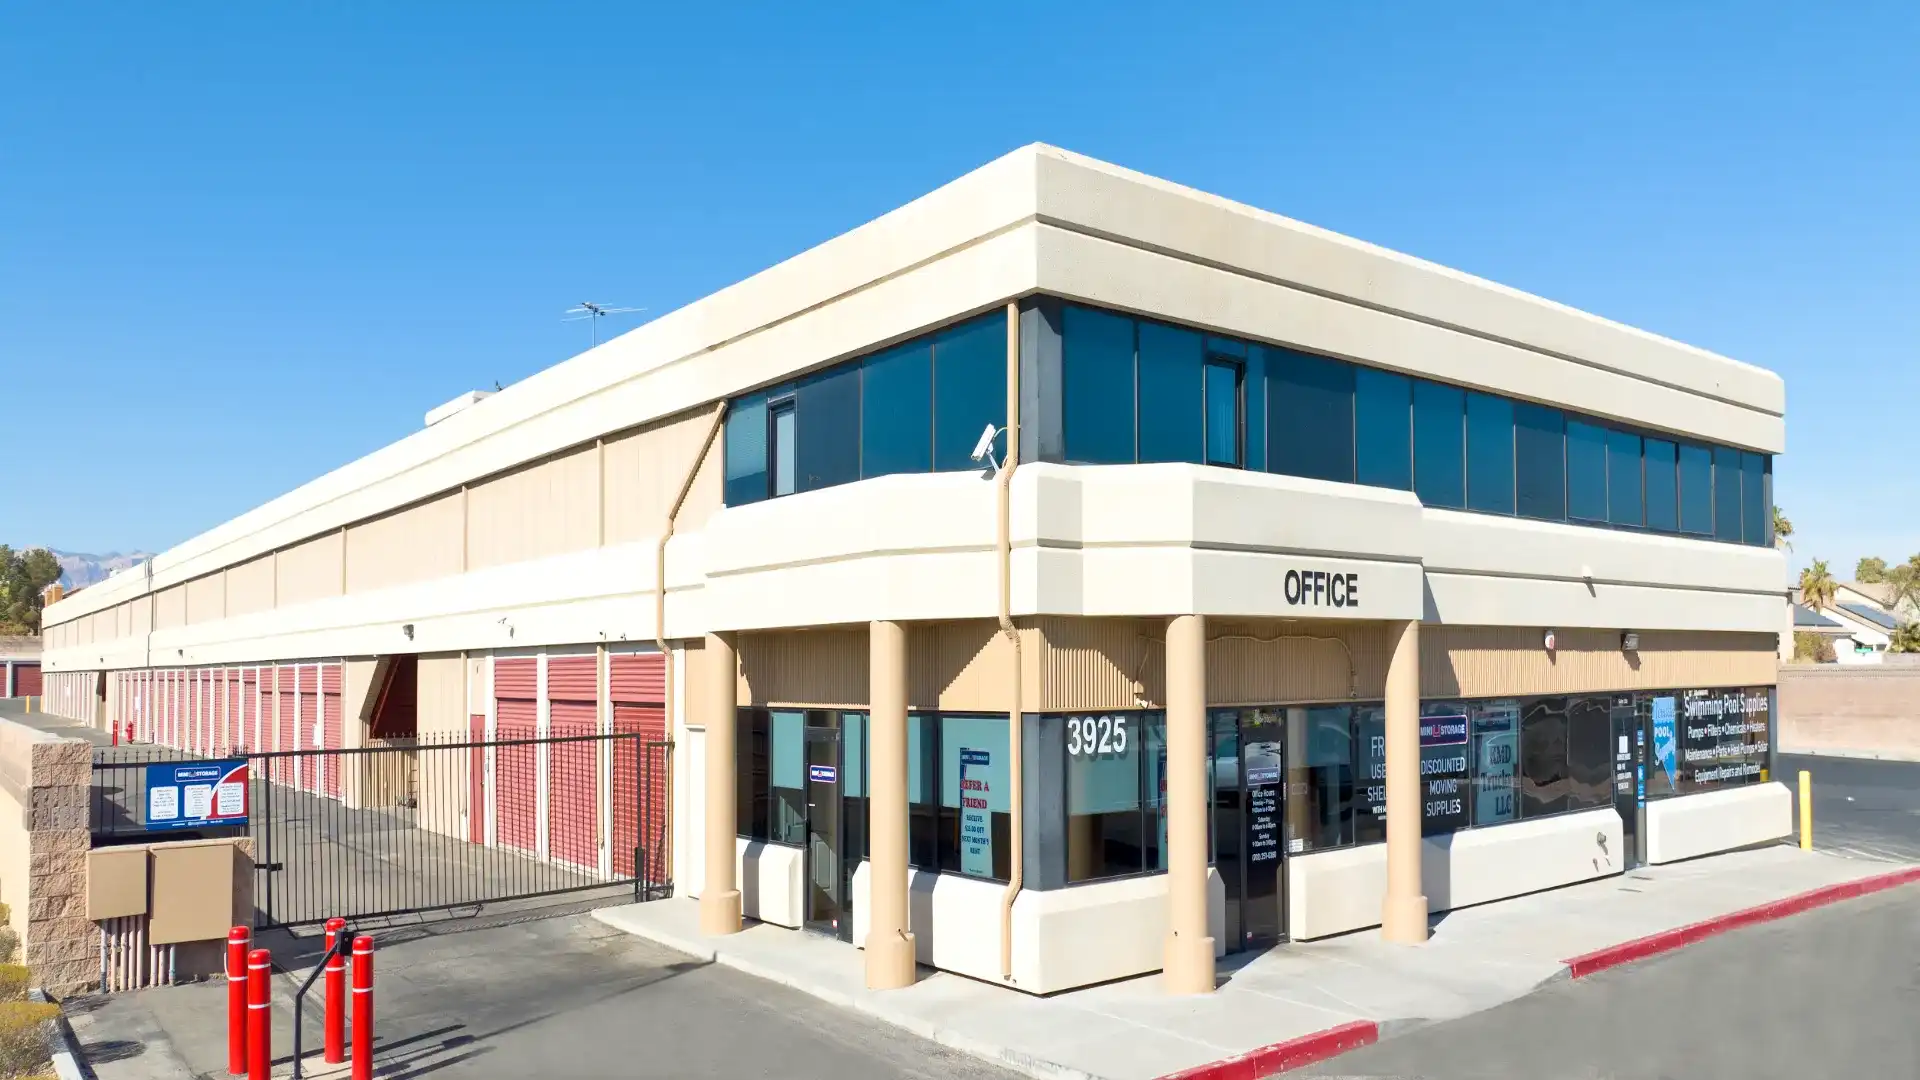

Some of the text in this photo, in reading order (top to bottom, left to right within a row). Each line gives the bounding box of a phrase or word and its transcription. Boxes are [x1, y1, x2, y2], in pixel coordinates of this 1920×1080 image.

[1284, 568, 1358, 608] OFFICE
[1684, 696, 1723, 720] Swimming
[1724, 694, 1739, 713] Pool
[1740, 692, 1768, 717] Supplies
[1067, 716, 1127, 755] 3925
[1420, 725, 1433, 736] MINI
[1441, 724, 1466, 736] STORAGE
[1655, 726, 1670, 737] POOL
[1688, 720, 1766, 741] Pumps Filters Chemicals Heaters
[1371, 736, 1385, 758] FR
[1685, 748, 1713, 762] Maintenance
[1716, 745, 1728, 758] Parts
[1741, 742, 1755, 757] Pumps
[1757, 740, 1769, 753] Solar
[1421, 757, 1465, 775] DISCOUNTED
[1695, 769, 1718, 785] Equipment
[1735, 763, 1743, 776] and
[984, 780, 990, 792] A
[1252, 790, 1263, 798] Office
[1429, 779, 1458, 796] MOVING
[961, 797, 988, 809] FRIEND
[1426, 799, 1461, 817] SUPPLIES
[1495, 795, 1512, 816] LLC
